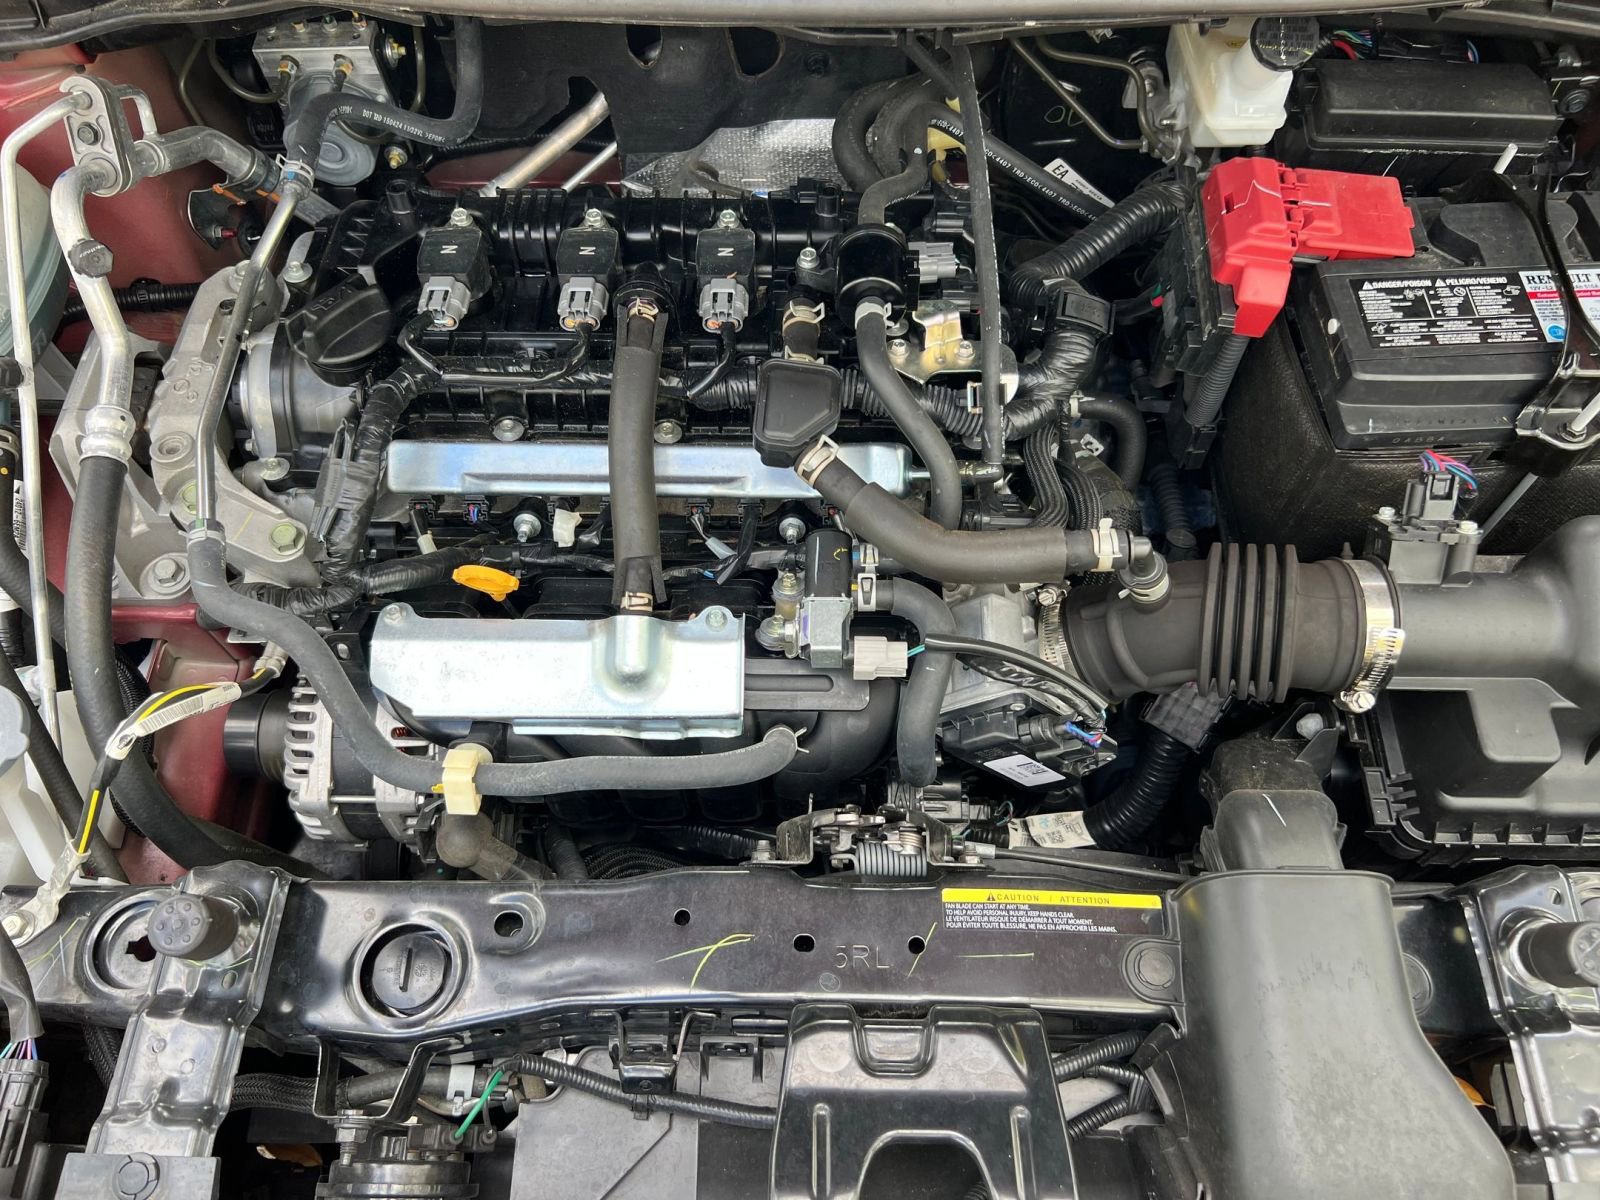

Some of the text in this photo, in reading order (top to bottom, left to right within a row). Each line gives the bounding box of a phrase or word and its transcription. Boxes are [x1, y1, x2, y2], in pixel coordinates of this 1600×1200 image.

[1052, 164, 1069, 180] EA
[1372, 277, 1508, 289] DANGER/POISON PELIGRO/VENENO
[1525, 274, 1591, 285] RENULT
[997, 893, 1110, 905] CAUTION ATTENTION
